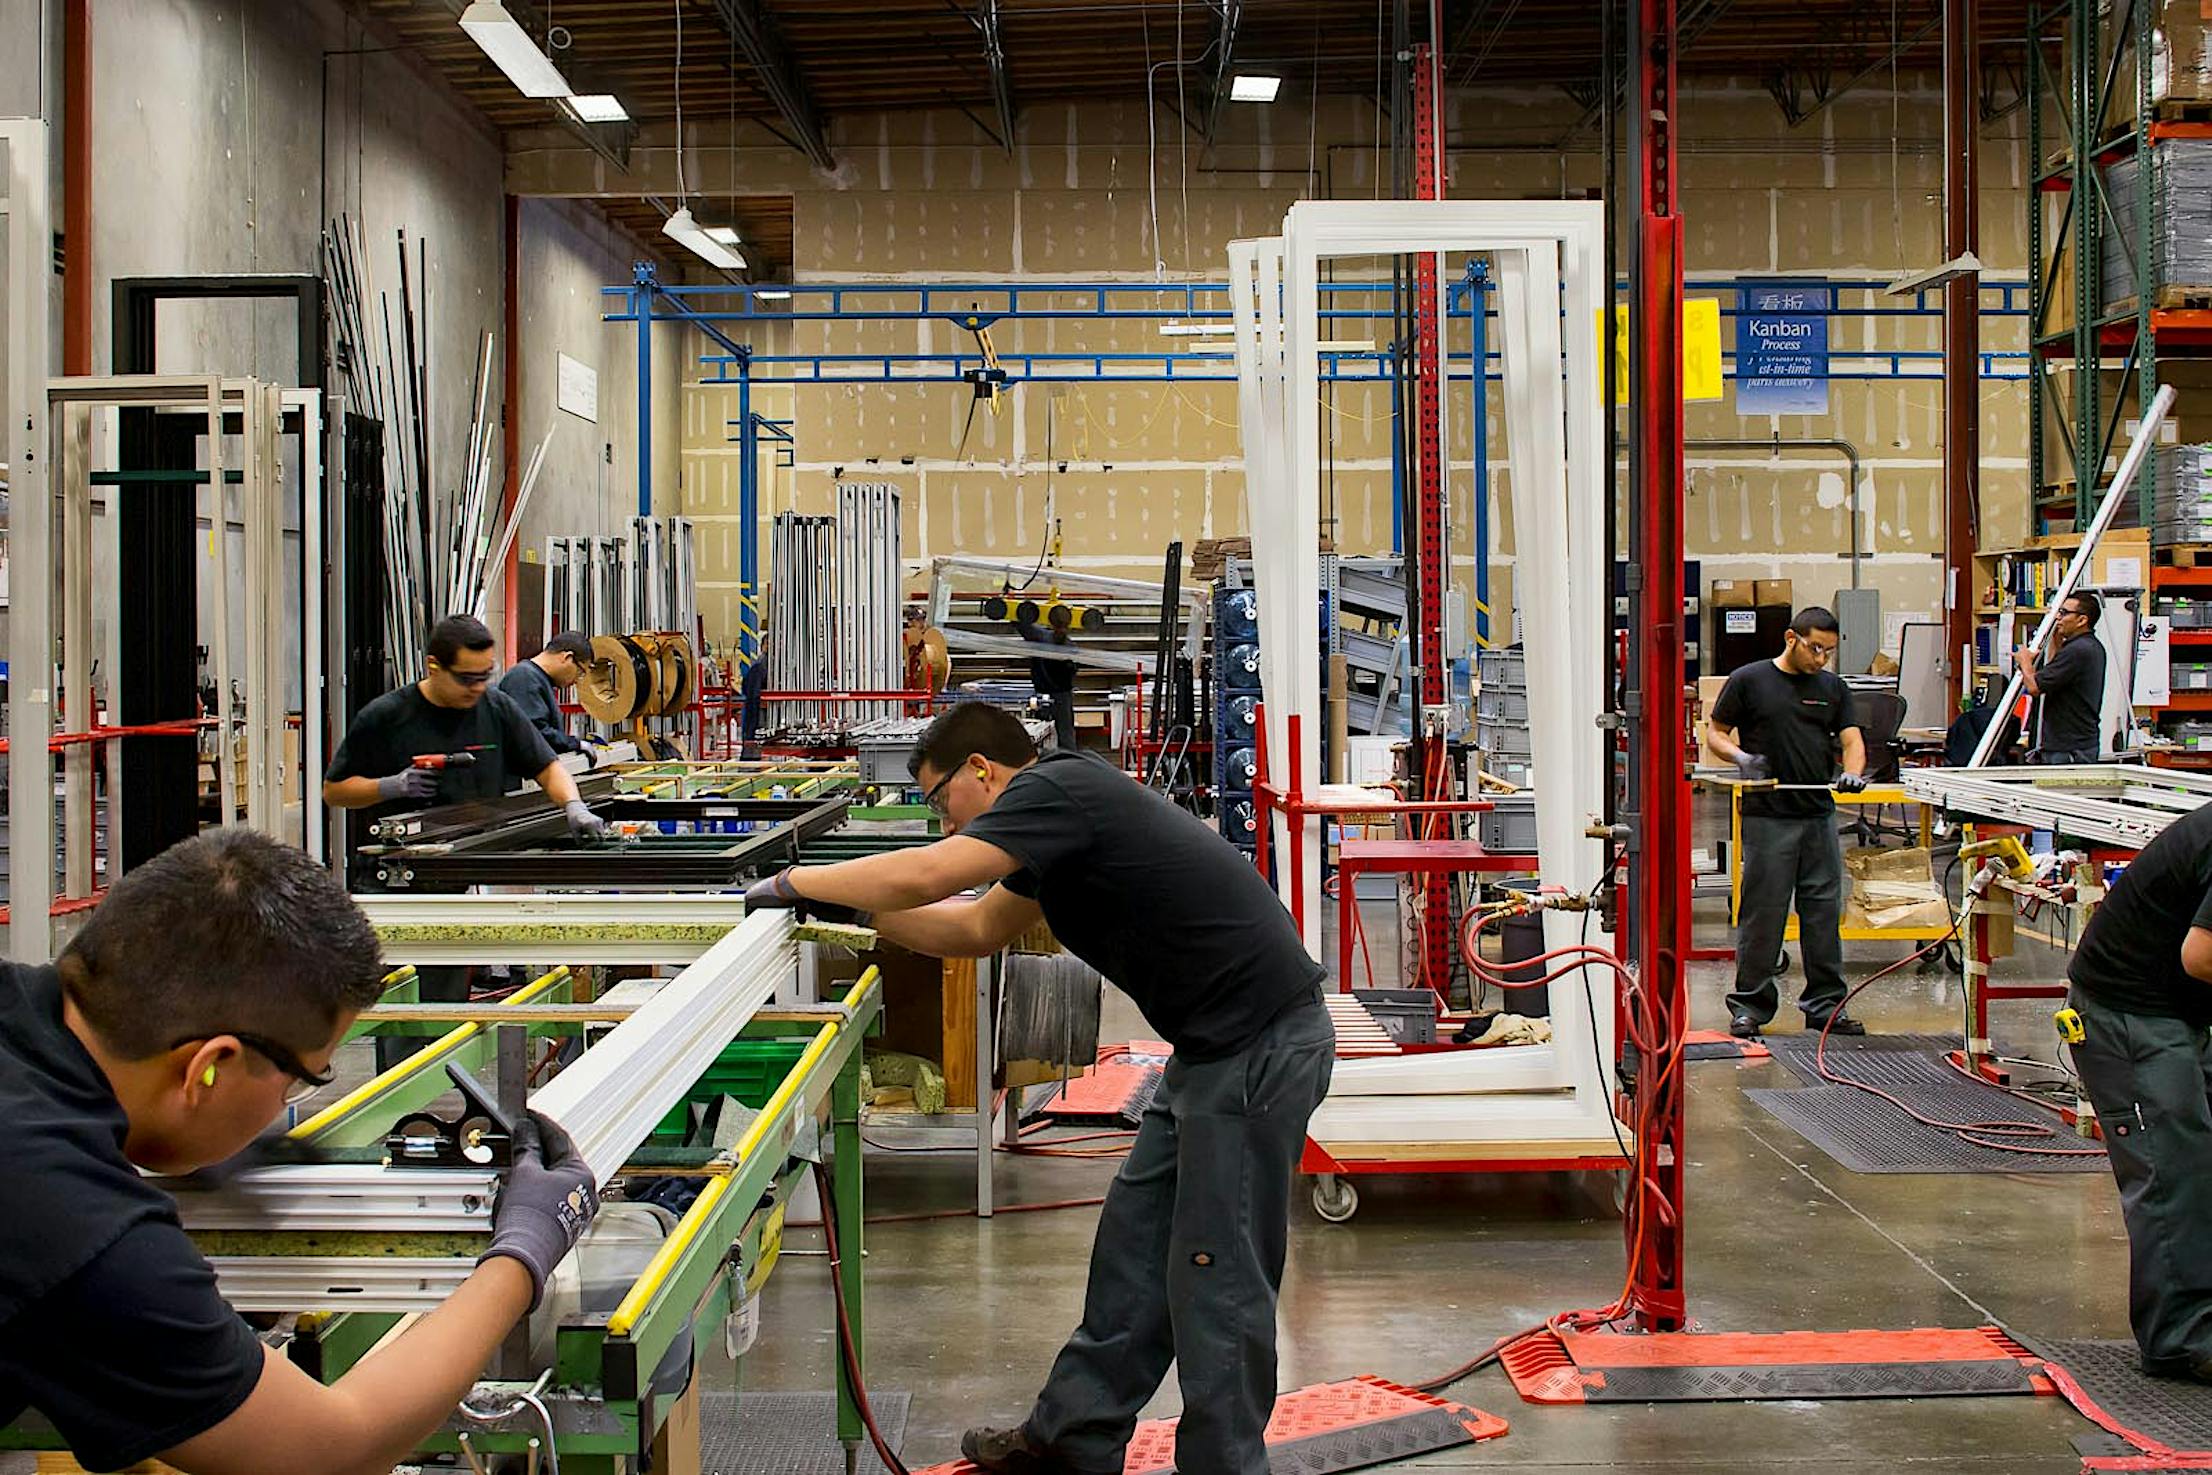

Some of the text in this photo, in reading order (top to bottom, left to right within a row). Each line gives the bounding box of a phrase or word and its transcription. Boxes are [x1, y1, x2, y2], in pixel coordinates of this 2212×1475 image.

[1749, 320, 1811, 337] Kanban
[1761, 339, 1801, 350] Process
[1758, 363, 1811, 374] st-in-time
